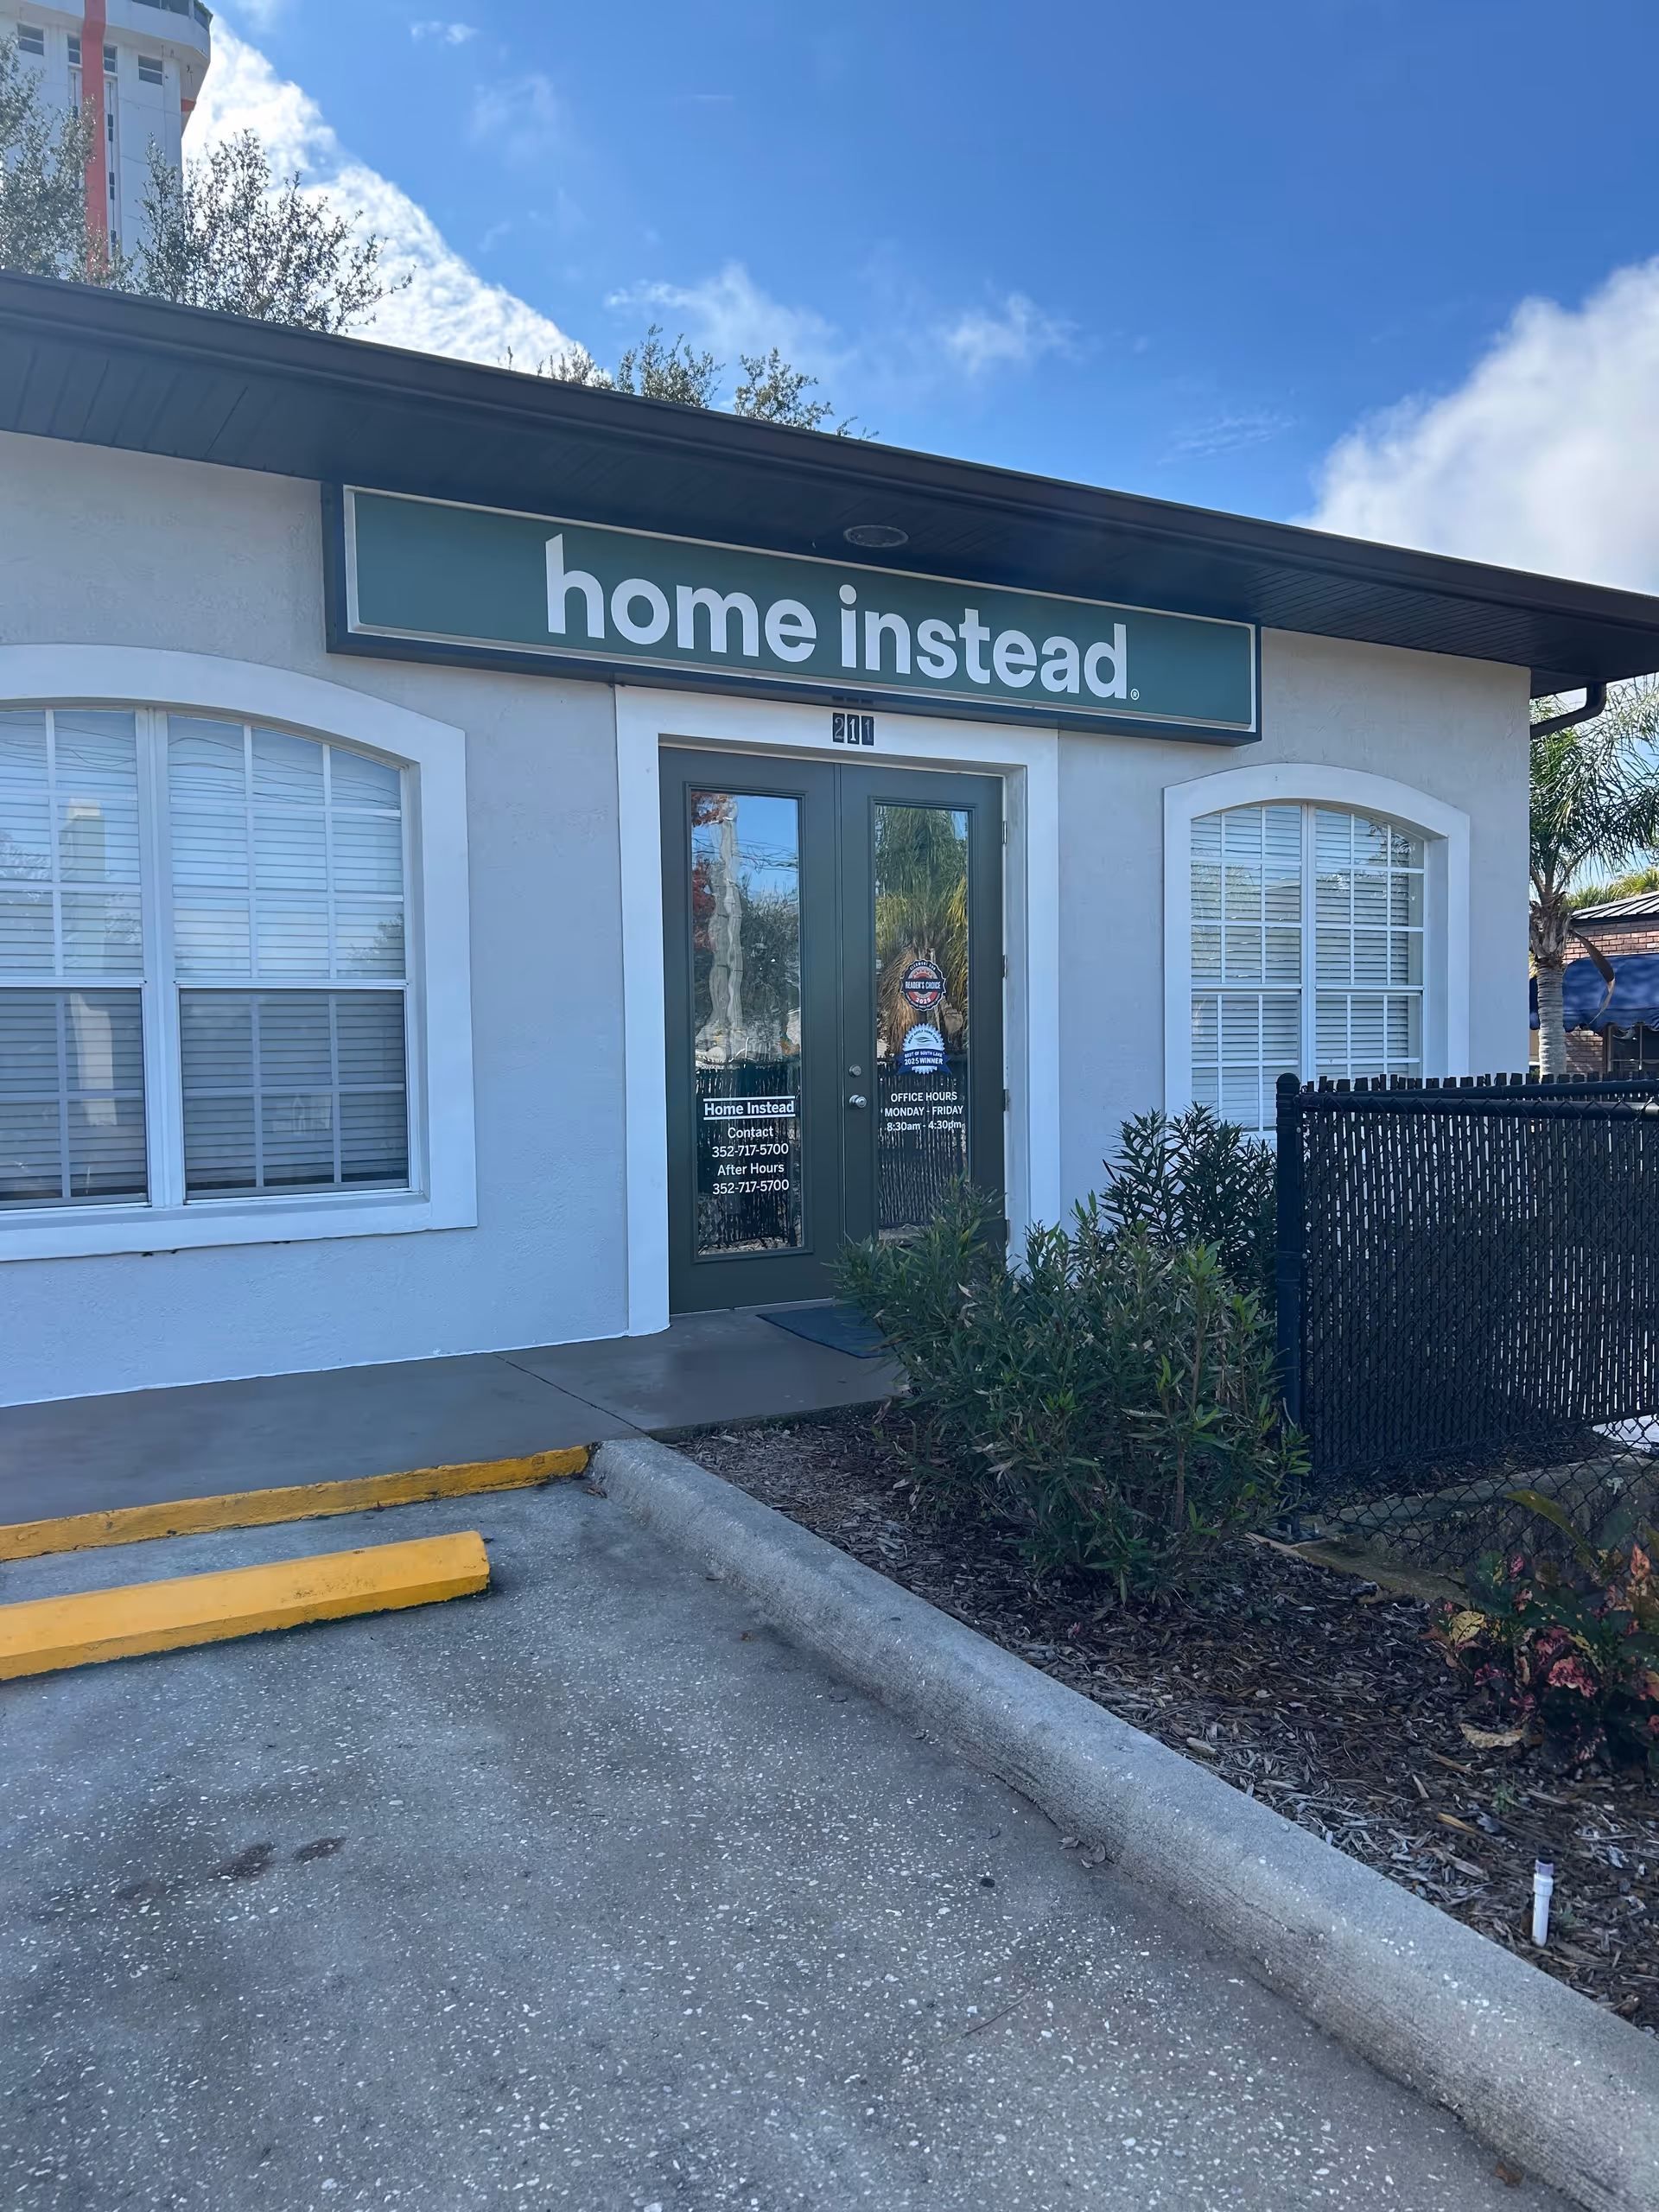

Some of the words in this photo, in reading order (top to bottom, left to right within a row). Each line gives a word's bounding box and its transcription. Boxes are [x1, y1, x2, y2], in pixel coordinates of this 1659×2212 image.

[546, 534, 817, 663] home
[834, 717, 873, 741] 211
[905, 981, 925, 989] READER'S
[925, 981, 941, 989] CHOICE
[891, 1092, 924, 1103] OFFICE
[925, 1091, 957, 1101] HOURS
[704, 1103, 743, 1116] Home
[747, 1100, 794, 1114] Instead
[884, 1107, 925, 1116] MONDAY
[932, 1105, 963, 1116] FRIDAY
[728, 1126, 774, 1139] Contact
[887, 1122, 920, 1132] 8:30am
[928, 1120, 962, 1131] 4:30pm
[711, 1142, 789, 1158] 352-717-5700
[717, 1164, 747, 1176] After
[750, 1162, 785, 1174] Hours
[712, 1179, 790, 1195] 352-717-5700
